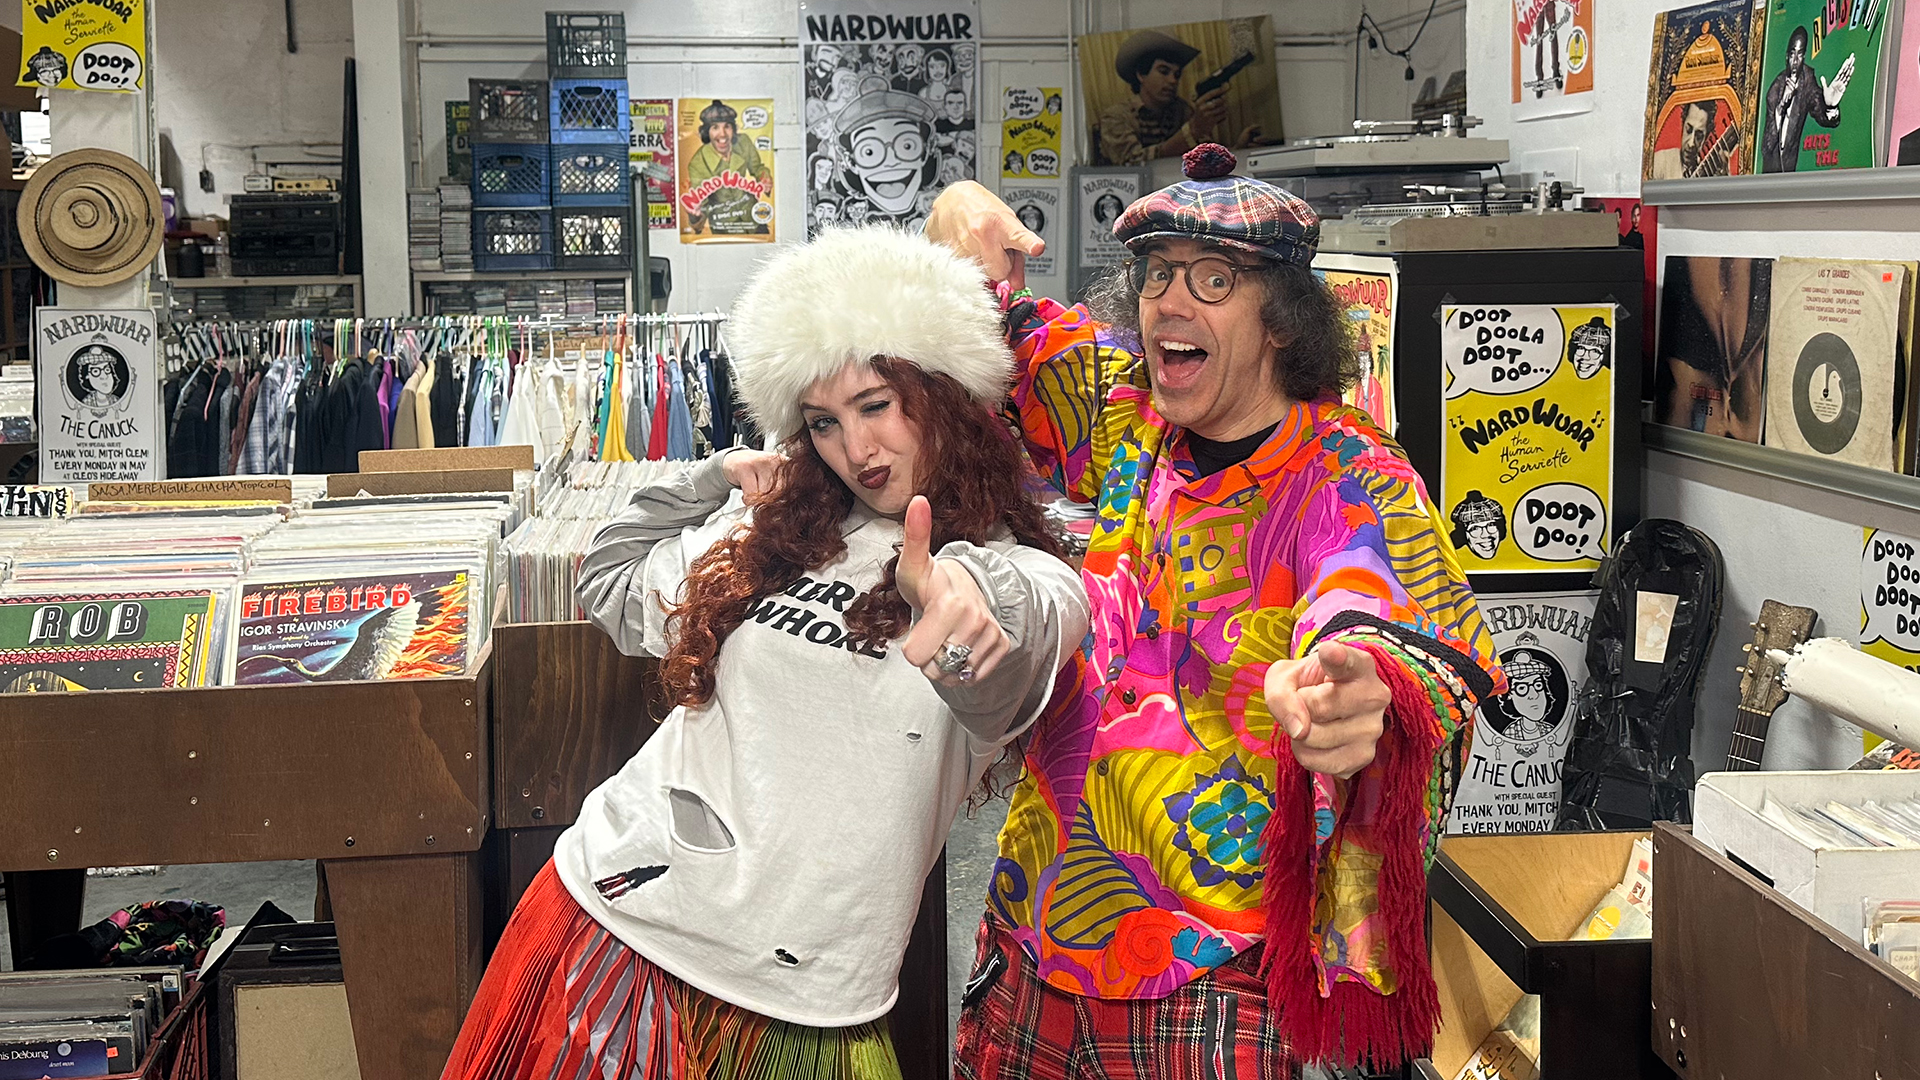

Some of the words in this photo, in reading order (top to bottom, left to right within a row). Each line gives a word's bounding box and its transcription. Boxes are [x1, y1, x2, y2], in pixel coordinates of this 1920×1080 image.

[71, 9, 86, 18] the
[63, 21, 117, 45] Serviette
[64, 18, 96, 31] Human
[806, 13, 973, 42] NARDWUAR
[83, 53, 135, 74] DOOT
[86, 71, 129, 88] DOO!
[1803, 133, 1831, 150] HITS
[1816, 149, 1839, 166] THE
[681, 171, 764, 210] NARDWUAR
[1083, 179, 1135, 195] NARDWUAR
[1005, 190, 1056, 206] NARDWUAR
[1826, 269, 1831, 278] 7
[1459, 309, 1511, 329] DOOT
[43, 314, 151, 346] NARDWUAR
[1477, 326, 1544, 345] DOOLA
[1463, 345, 1522, 365] DOOT
[1492, 362, 1551, 383] DOO...
[60, 415, 85, 438] THE
[88, 417, 138, 439] CANUCK
[1459, 397, 1595, 454] NARDWUAR
[1511, 431, 1530, 446] the
[49, 449, 76, 460] THANK
[79, 449, 97, 459] YOU,
[98, 449, 123, 459] MITCH
[1500, 446, 1544, 464] Human
[54, 461, 82, 470] EVERY
[85, 461, 117, 471] MONDAY
[120, 461, 127, 470] IN
[129, 461, 147, 471] MAY
[1499, 447, 1571, 484] Serviette
[73, 471, 98, 480] CLEO'S
[100, 471, 139, 481] HIDEAWAY
[1526, 499, 1596, 529] DOOT
[1534, 526, 1589, 554] DOO!
[1873, 540, 1915, 562] DOOT
[1887, 562, 1920, 585] DOO
[241, 586, 412, 619] FIREBIRD
[1875, 584, 1920, 615] DOOT
[28, 602, 149, 645] ROB
[241, 625, 272, 637] IGOR
[277, 619, 349, 634] STRAVINSKY
[1481, 604, 1593, 643] RDWUA
[1896, 613, 1920, 637] DO
[268, 641, 303, 651] Symphony
[304, 639, 337, 647] Orchestra
[1473, 754, 1507, 787] THE
[1511, 758, 1563, 788] CANUC
[1494, 793, 1510, 802] WITH
[1511, 792, 1535, 800] SPECIAL
[1537, 791, 1557, 799] GUEST
[1455, 804, 1493, 820] THANK
[1497, 803, 1521, 816] YOU,
[1525, 801, 1559, 817] MITCH
[1462, 821, 1502, 834] EVERY
[1504, 819, 1550, 834] MONDAY
[11, 1049, 49, 1059] DeYoung
